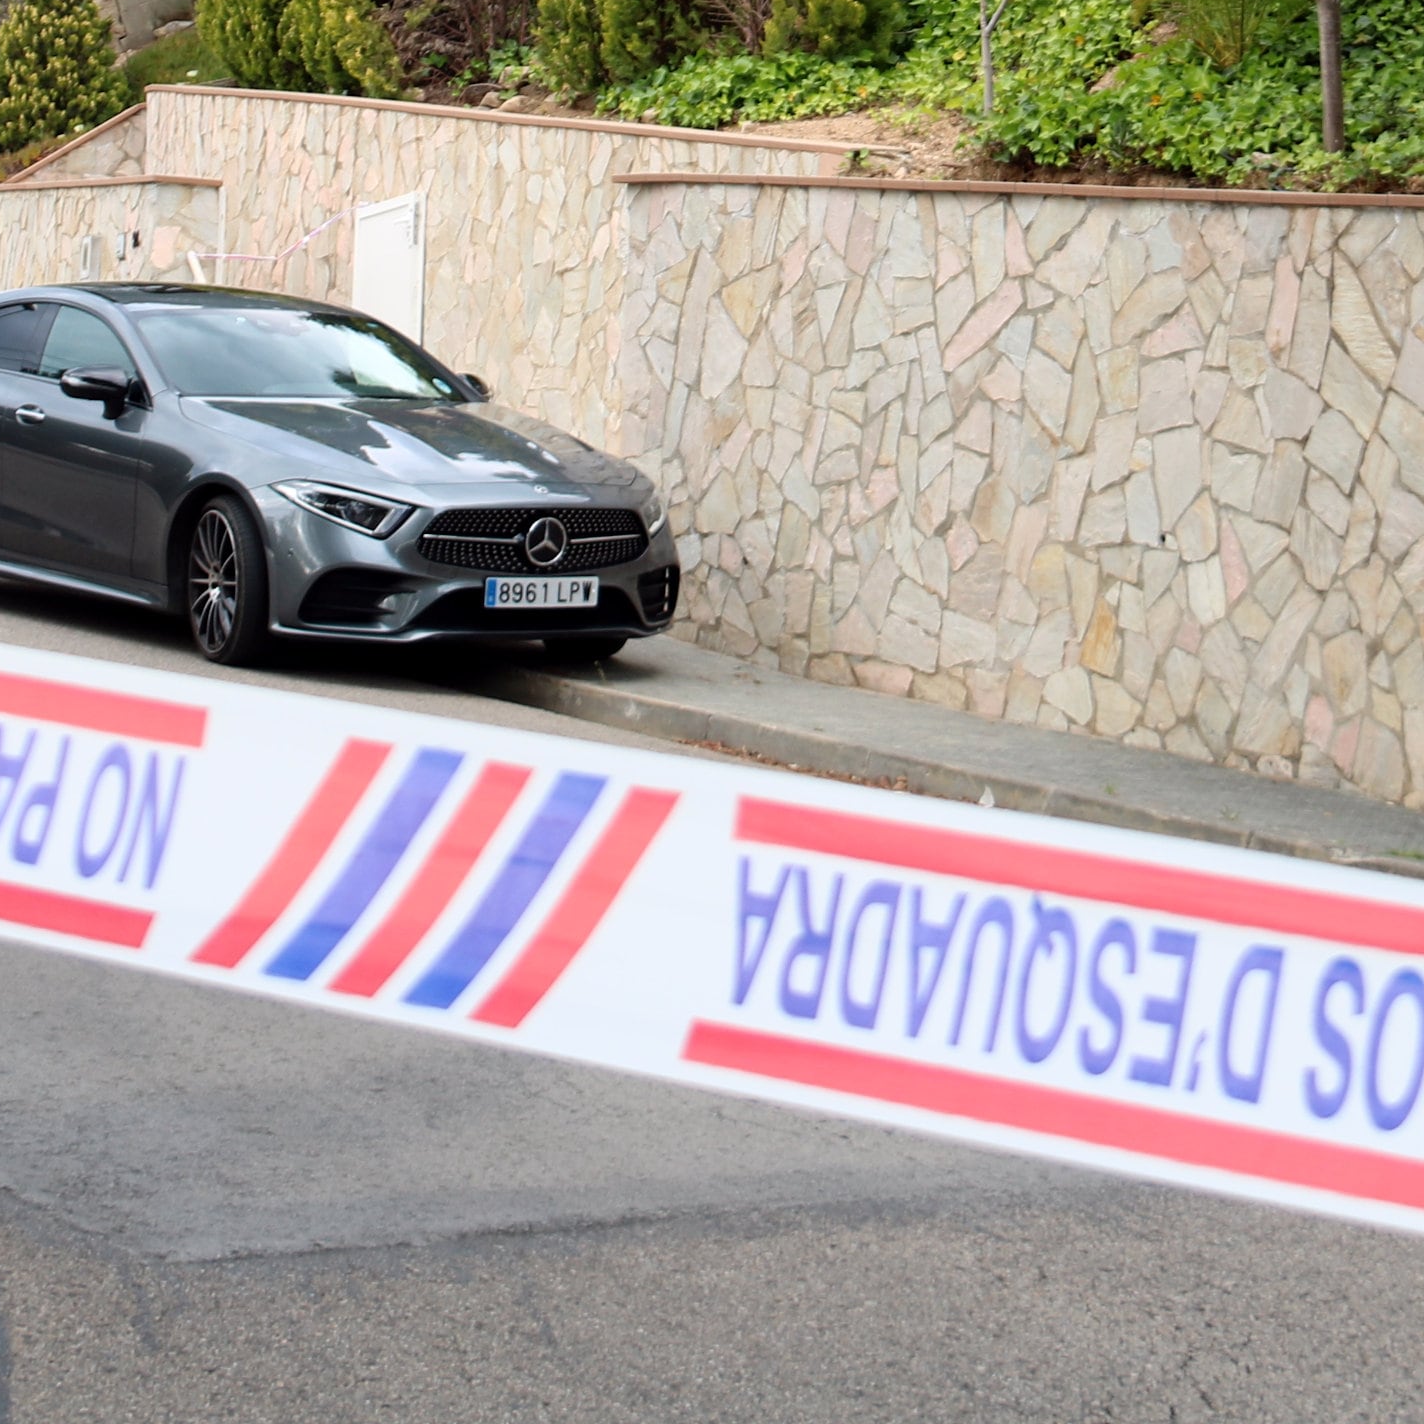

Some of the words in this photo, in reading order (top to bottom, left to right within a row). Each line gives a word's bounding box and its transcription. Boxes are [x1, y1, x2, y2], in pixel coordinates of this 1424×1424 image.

[498, 581, 549, 604] 8961
[556, 580, 593, 603] LPW
[73, 743, 188, 892] NO
[729, 854, 1289, 1107] D'ESQUADRA
